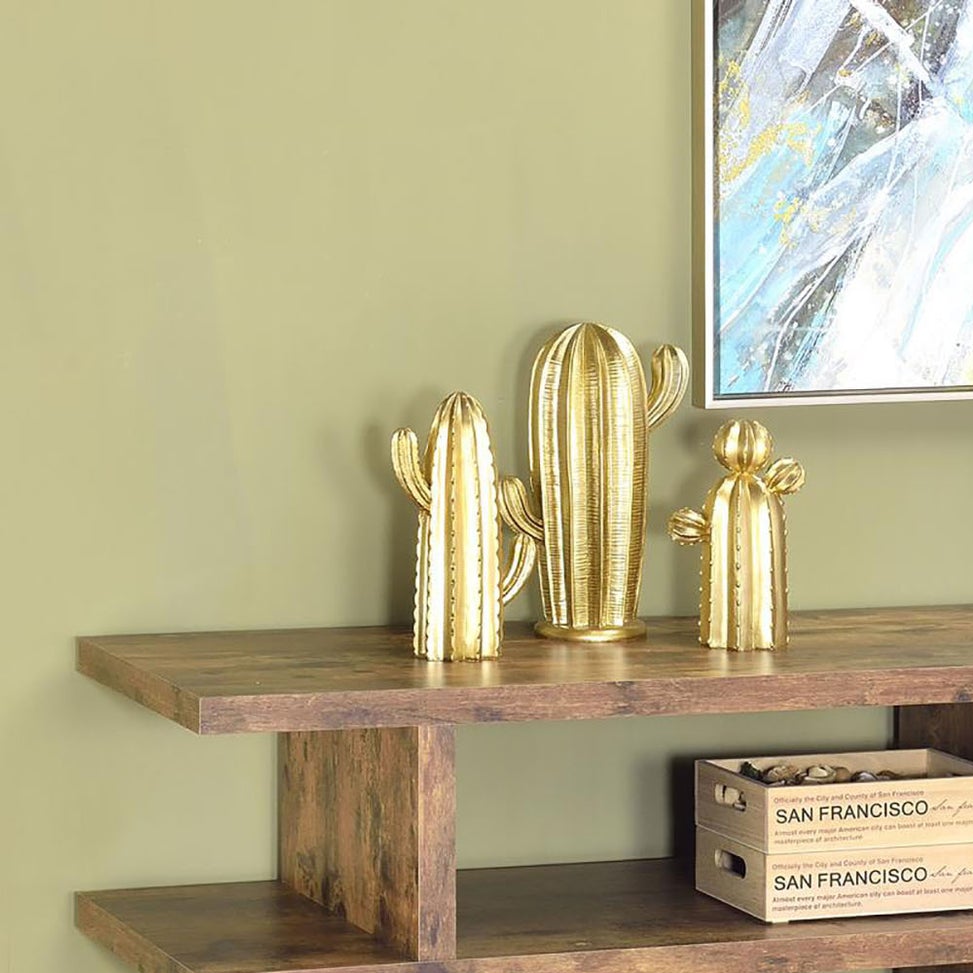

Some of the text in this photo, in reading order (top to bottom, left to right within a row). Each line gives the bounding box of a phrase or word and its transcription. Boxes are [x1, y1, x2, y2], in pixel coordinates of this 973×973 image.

[844, 793, 868, 801] County
[892, 790, 924, 798] Francisco
[776, 800, 928, 824] SAN FRANCISCO
[830, 860, 842, 868] and
[843, 859, 867, 867] County
[891, 856, 924, 864] Francisco
[774, 867, 928, 891] SAN FRANCISCO
[797, 895, 815, 903] every
[837, 892, 869, 900] American
